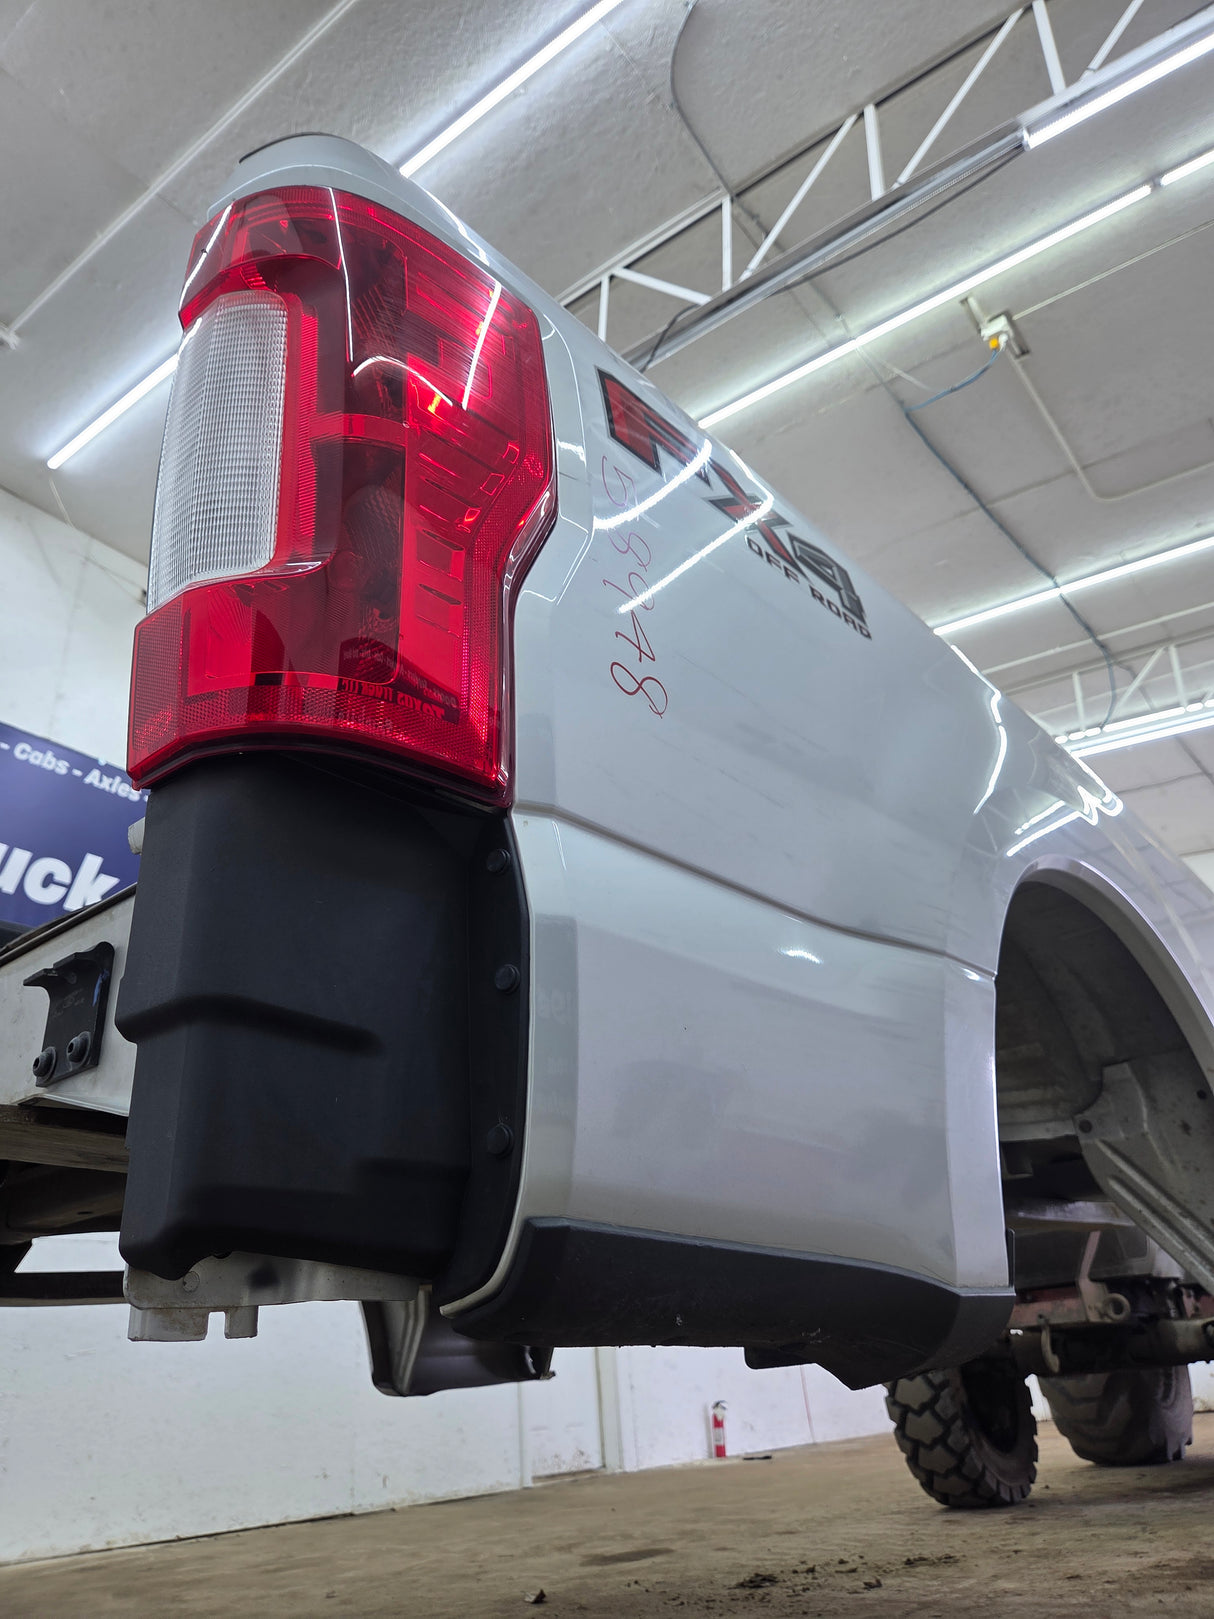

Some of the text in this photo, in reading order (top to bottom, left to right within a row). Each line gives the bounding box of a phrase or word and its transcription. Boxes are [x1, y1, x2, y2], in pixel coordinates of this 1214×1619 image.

[596, 365, 868, 628] FX4
[745, 535, 873, 641] OFF ROAD
[13, 742, 71, 775] Cabs
[83, 768, 141, 802] Axles
